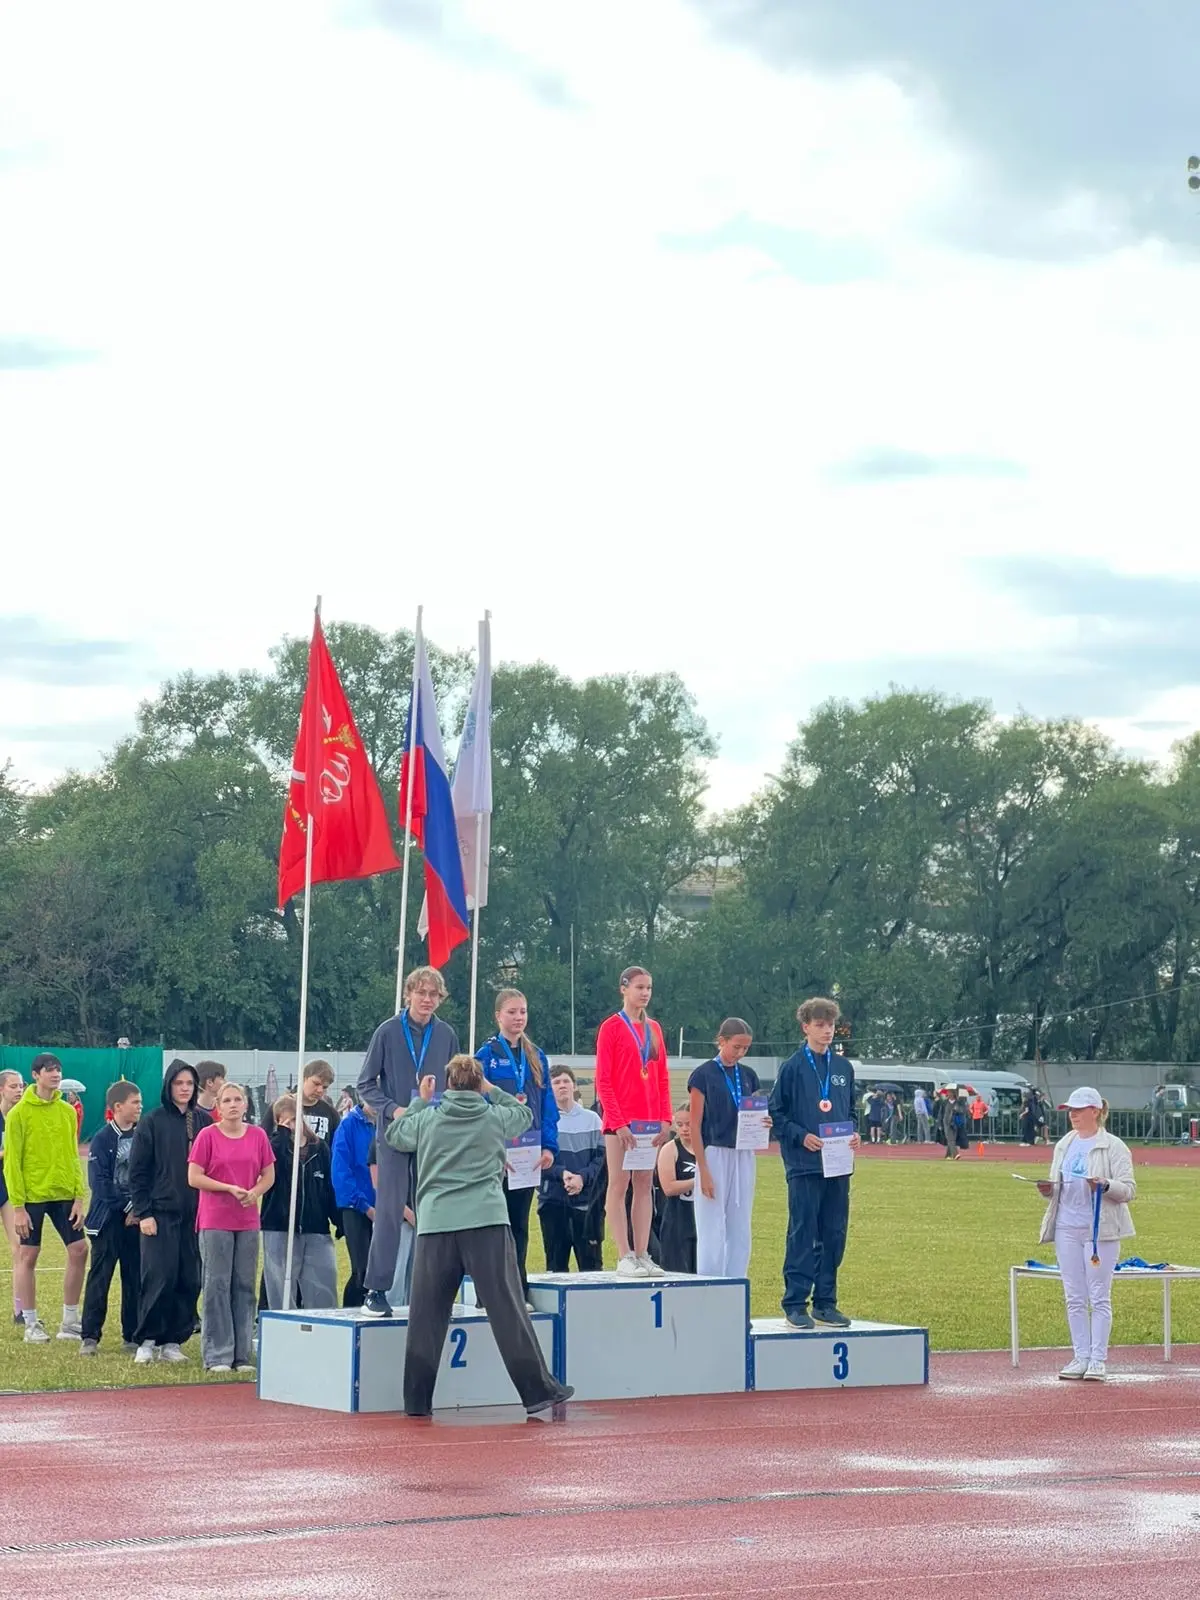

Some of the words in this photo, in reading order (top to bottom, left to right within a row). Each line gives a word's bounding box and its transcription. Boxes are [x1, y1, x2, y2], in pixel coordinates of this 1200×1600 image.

[650, 1291, 663, 1328] 1
[450, 1328, 467, 1368] 2
[833, 1342, 849, 1380] 3
